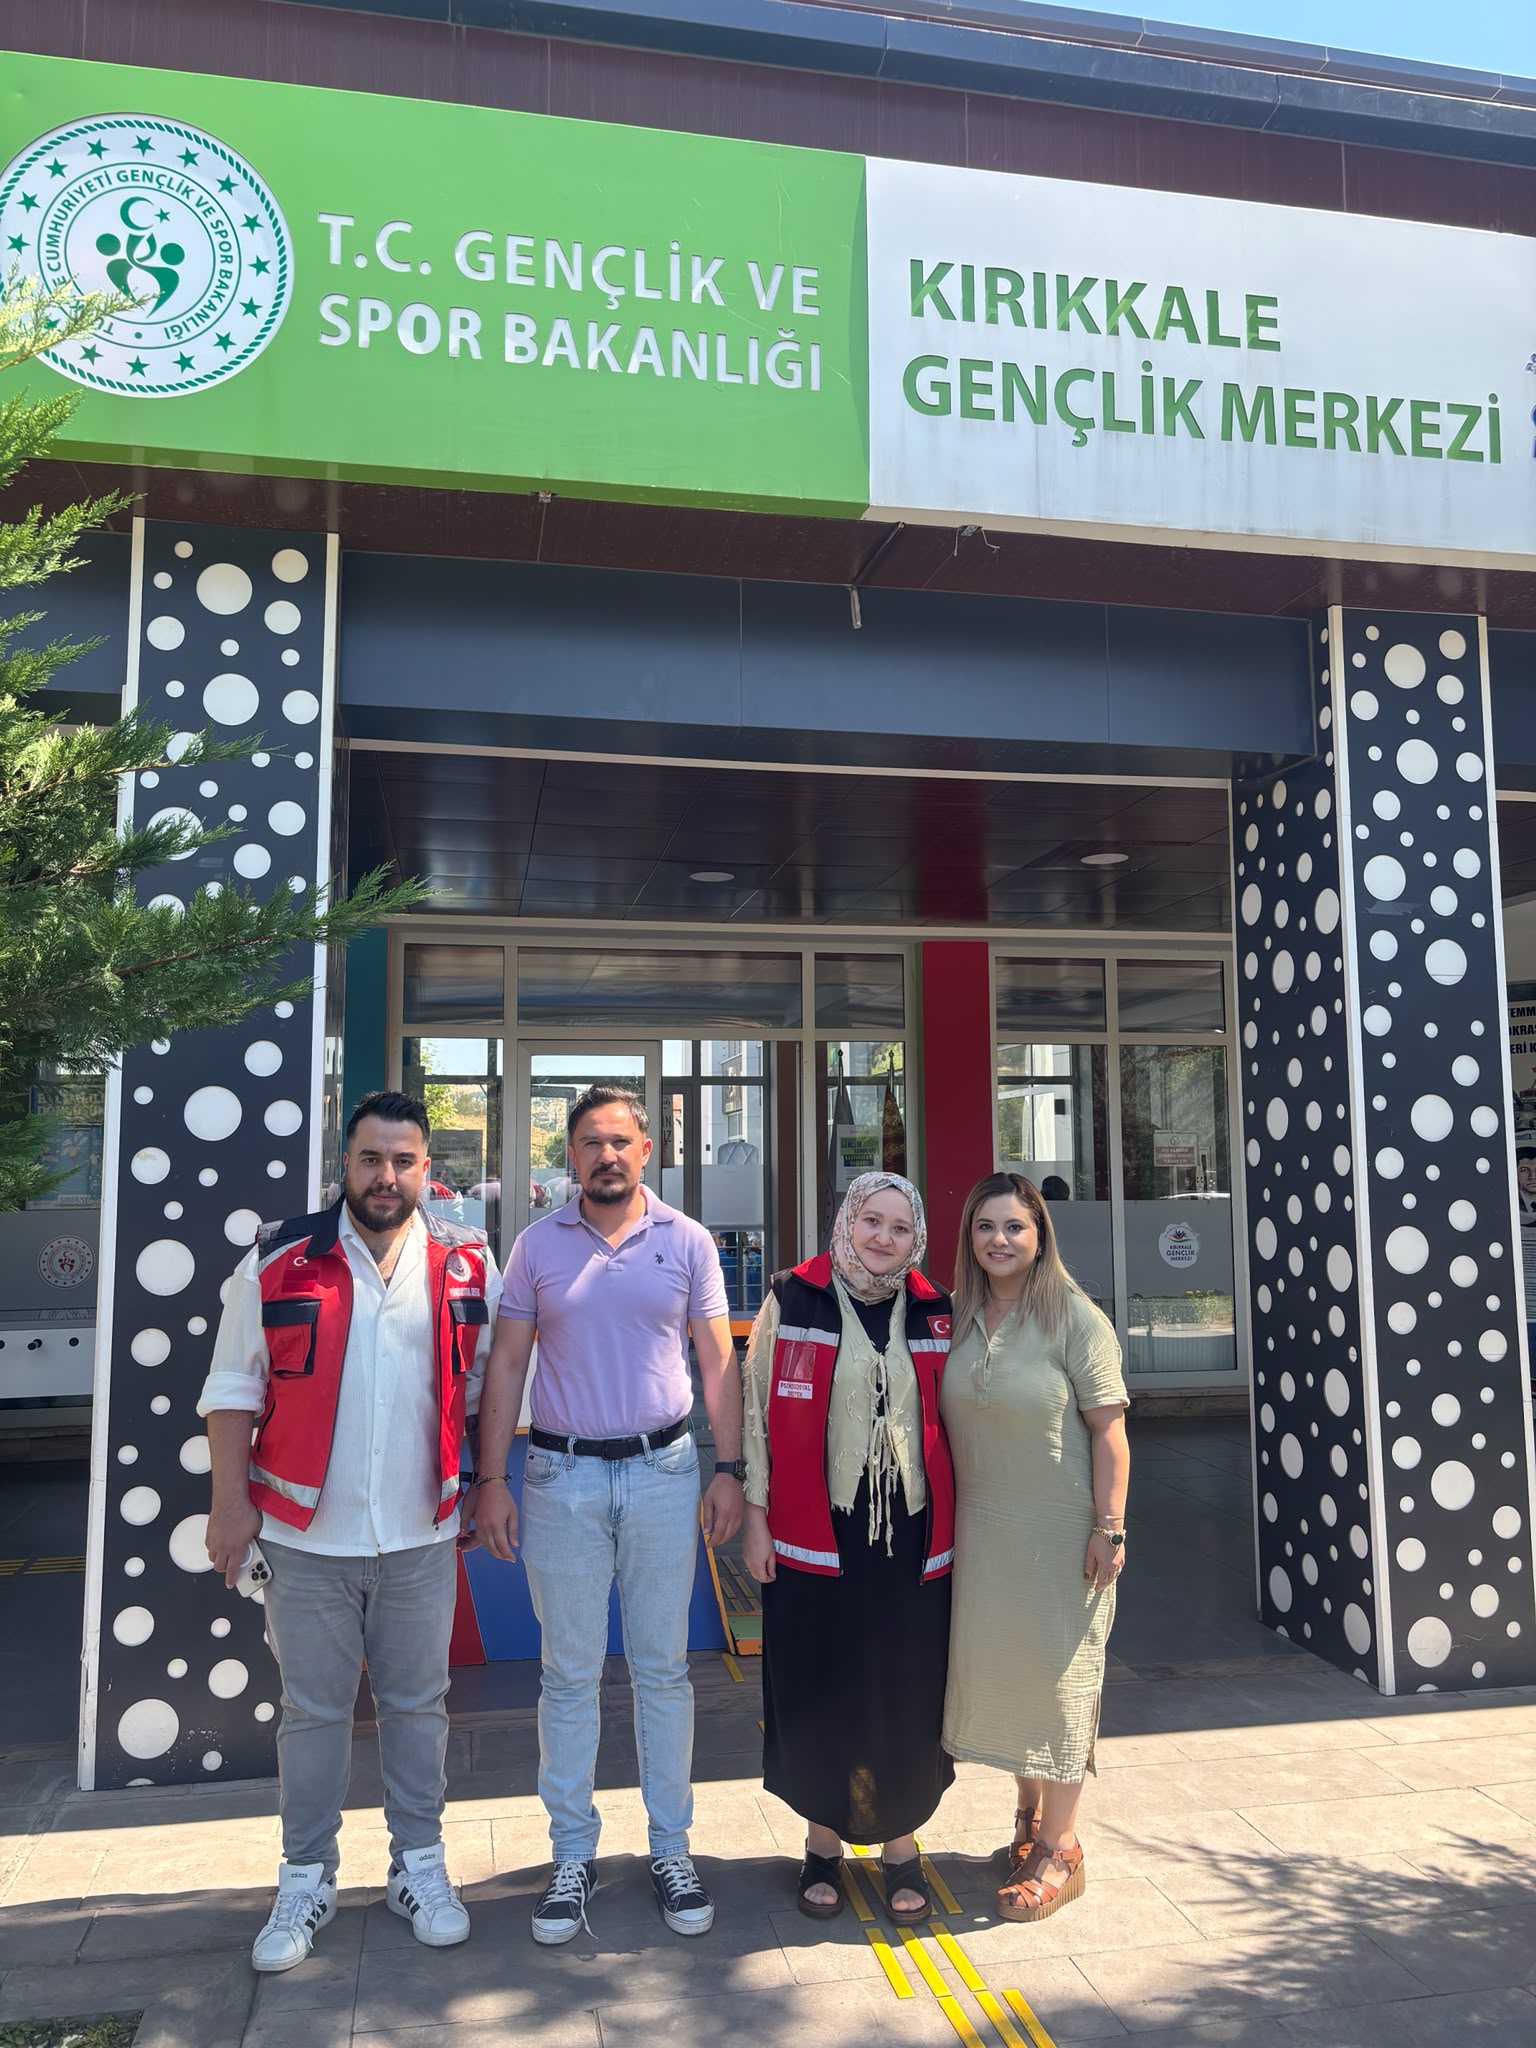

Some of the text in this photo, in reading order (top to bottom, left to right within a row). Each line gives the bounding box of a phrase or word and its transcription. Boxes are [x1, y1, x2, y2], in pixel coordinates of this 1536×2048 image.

[45, 169, 113, 272] CUMHURİYETİ
[116, 169, 195, 199] GENÇLİK
[194, 195, 216, 218] VE
[210, 219, 233, 263] SPOR
[318, 211, 820, 316] T.C. GENÇLİK VE
[163, 267, 234, 340] BAKANLIĞI
[318, 293, 822, 392] SPOR BAKANLIĞI
[909, 258, 1282, 353] KIRIKKALE
[902, 353, 1206, 448] GENÇLİK
[1220, 382, 1502, 465] MERKEZİ
[419, 1853, 436, 1862] adidas
